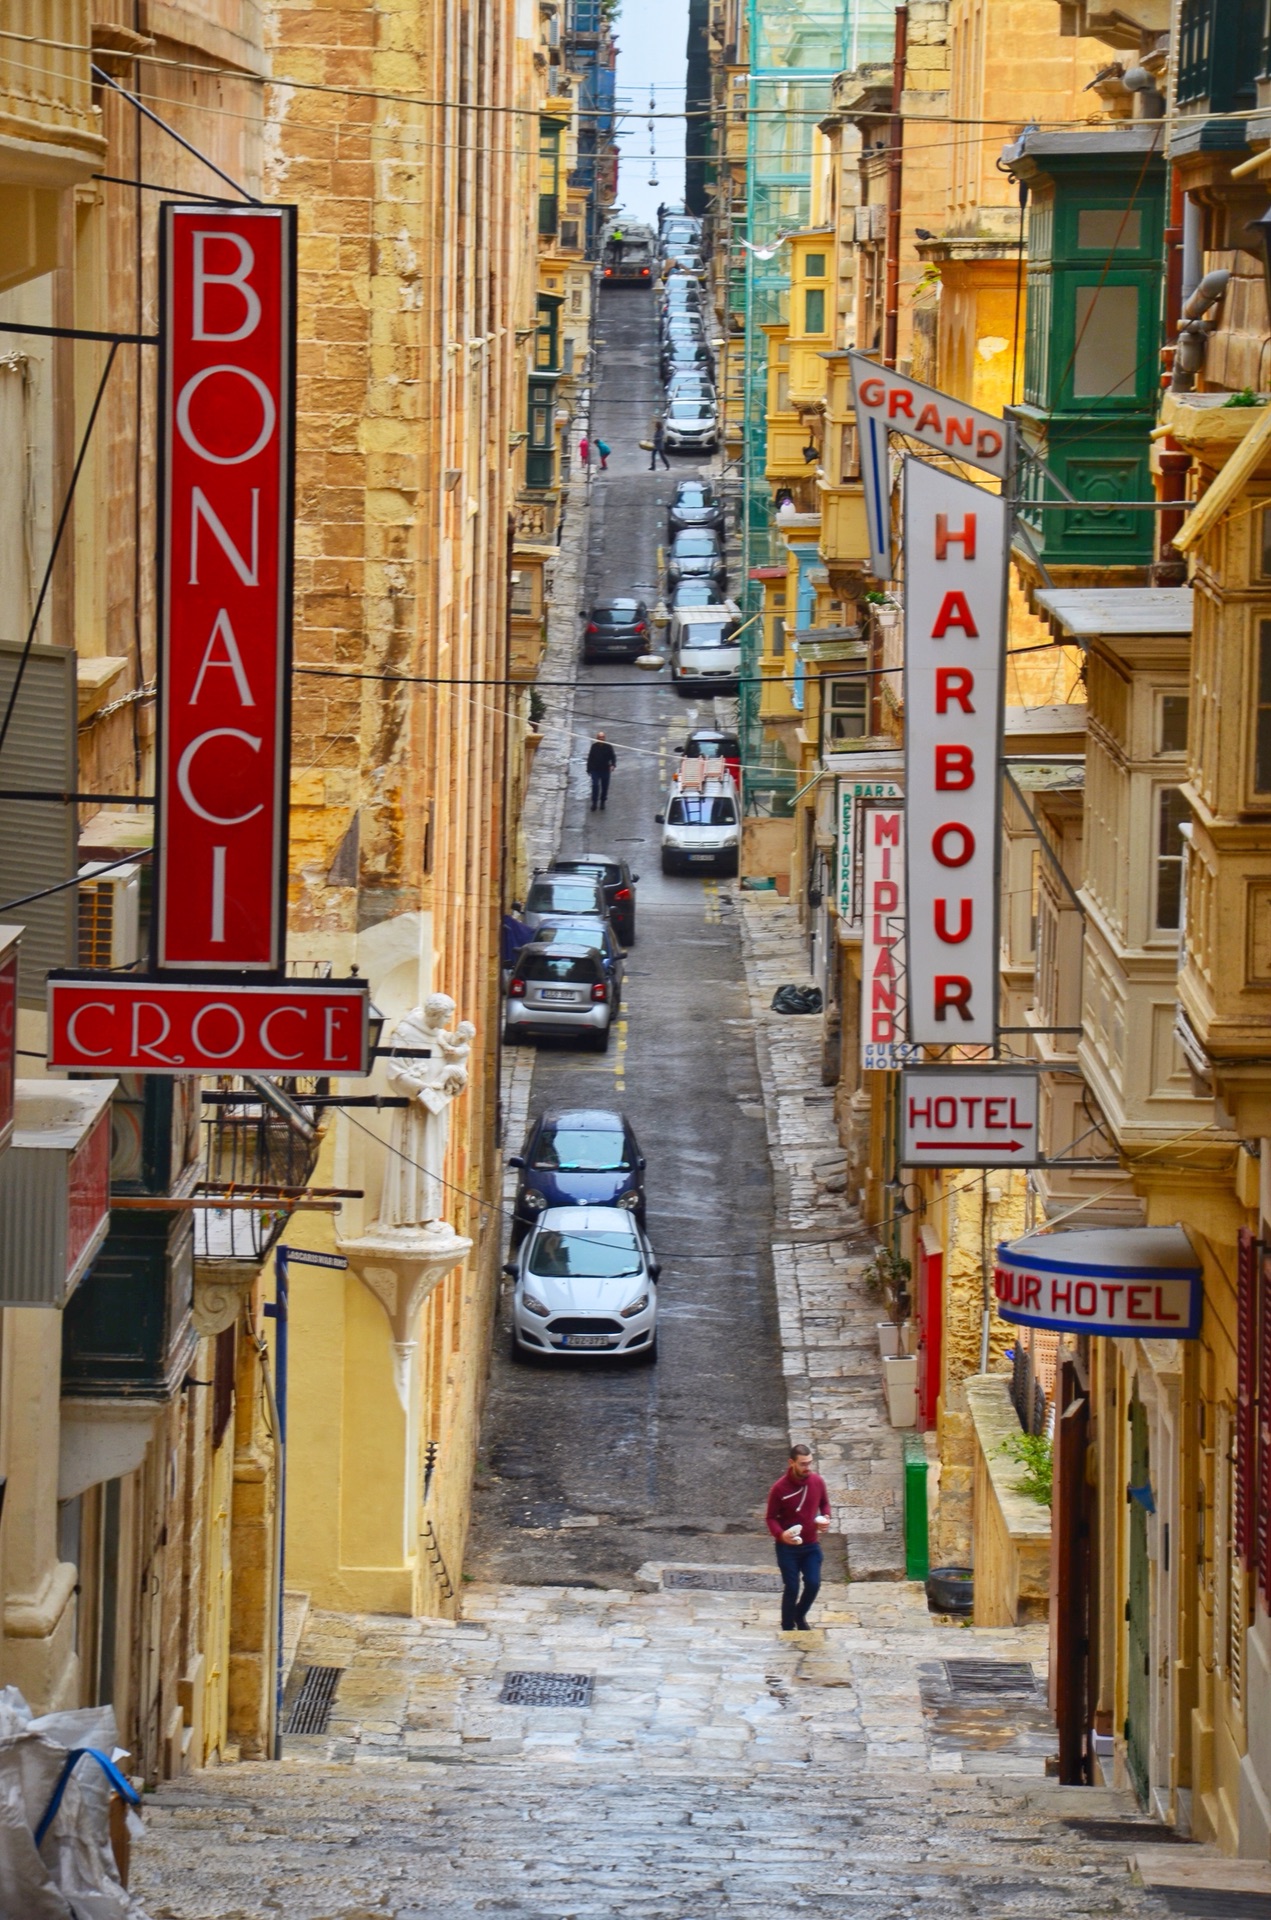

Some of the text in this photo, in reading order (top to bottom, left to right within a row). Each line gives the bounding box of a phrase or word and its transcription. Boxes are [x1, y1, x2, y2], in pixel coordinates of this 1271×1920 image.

[859, 377, 1003, 458] GRAND
[175, 231, 276, 943] BONACI
[854, 784, 896, 797] BAR &
[931, 513, 979, 1021] HARBOUR
[841, 793, 852, 918] RESTAURANT
[871, 814, 899, 1043] MIDLAND
[67, 1002, 349, 1065] CROCE
[909, 1096, 1033, 1129] HOTEL
[1052, 1278, 1180, 1321] HOTEL
